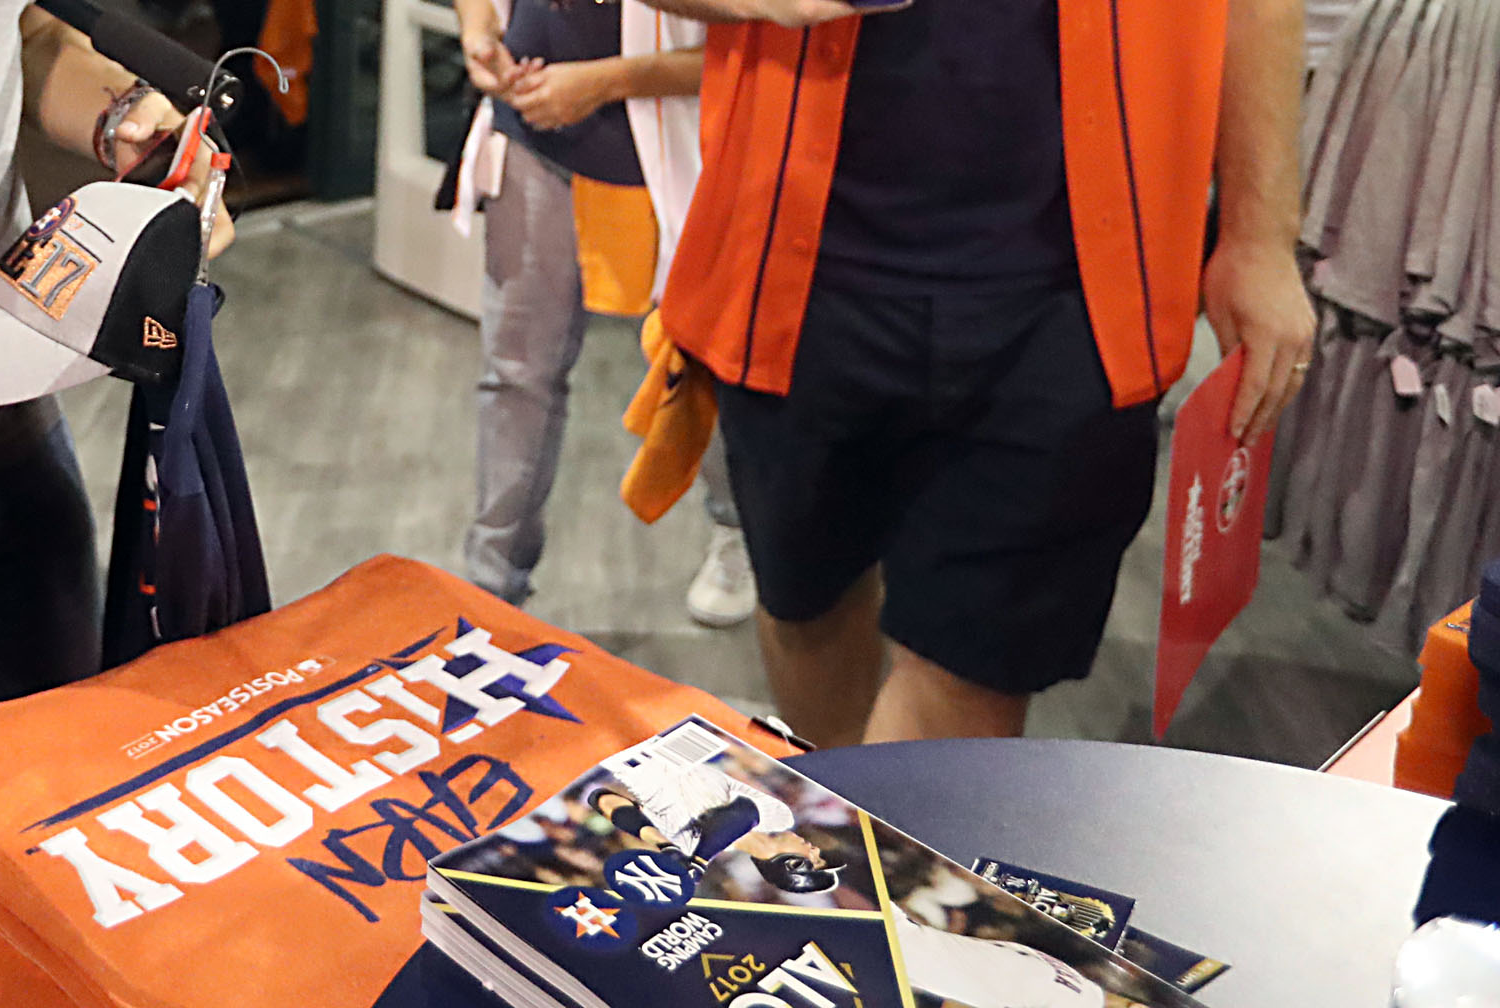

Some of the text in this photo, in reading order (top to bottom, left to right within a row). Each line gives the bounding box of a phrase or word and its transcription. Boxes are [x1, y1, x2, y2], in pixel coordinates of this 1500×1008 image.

[126, 668, 304, 758] POSTSEASON 2017
[37, 626, 572, 929] HISTORY
[286, 753, 535, 924] EARN
[561, 896, 618, 937] H
[640, 911, 709, 960] WORLD
[657, 922, 723, 972] CAMPING
[709, 953, 767, 1003] 2017
